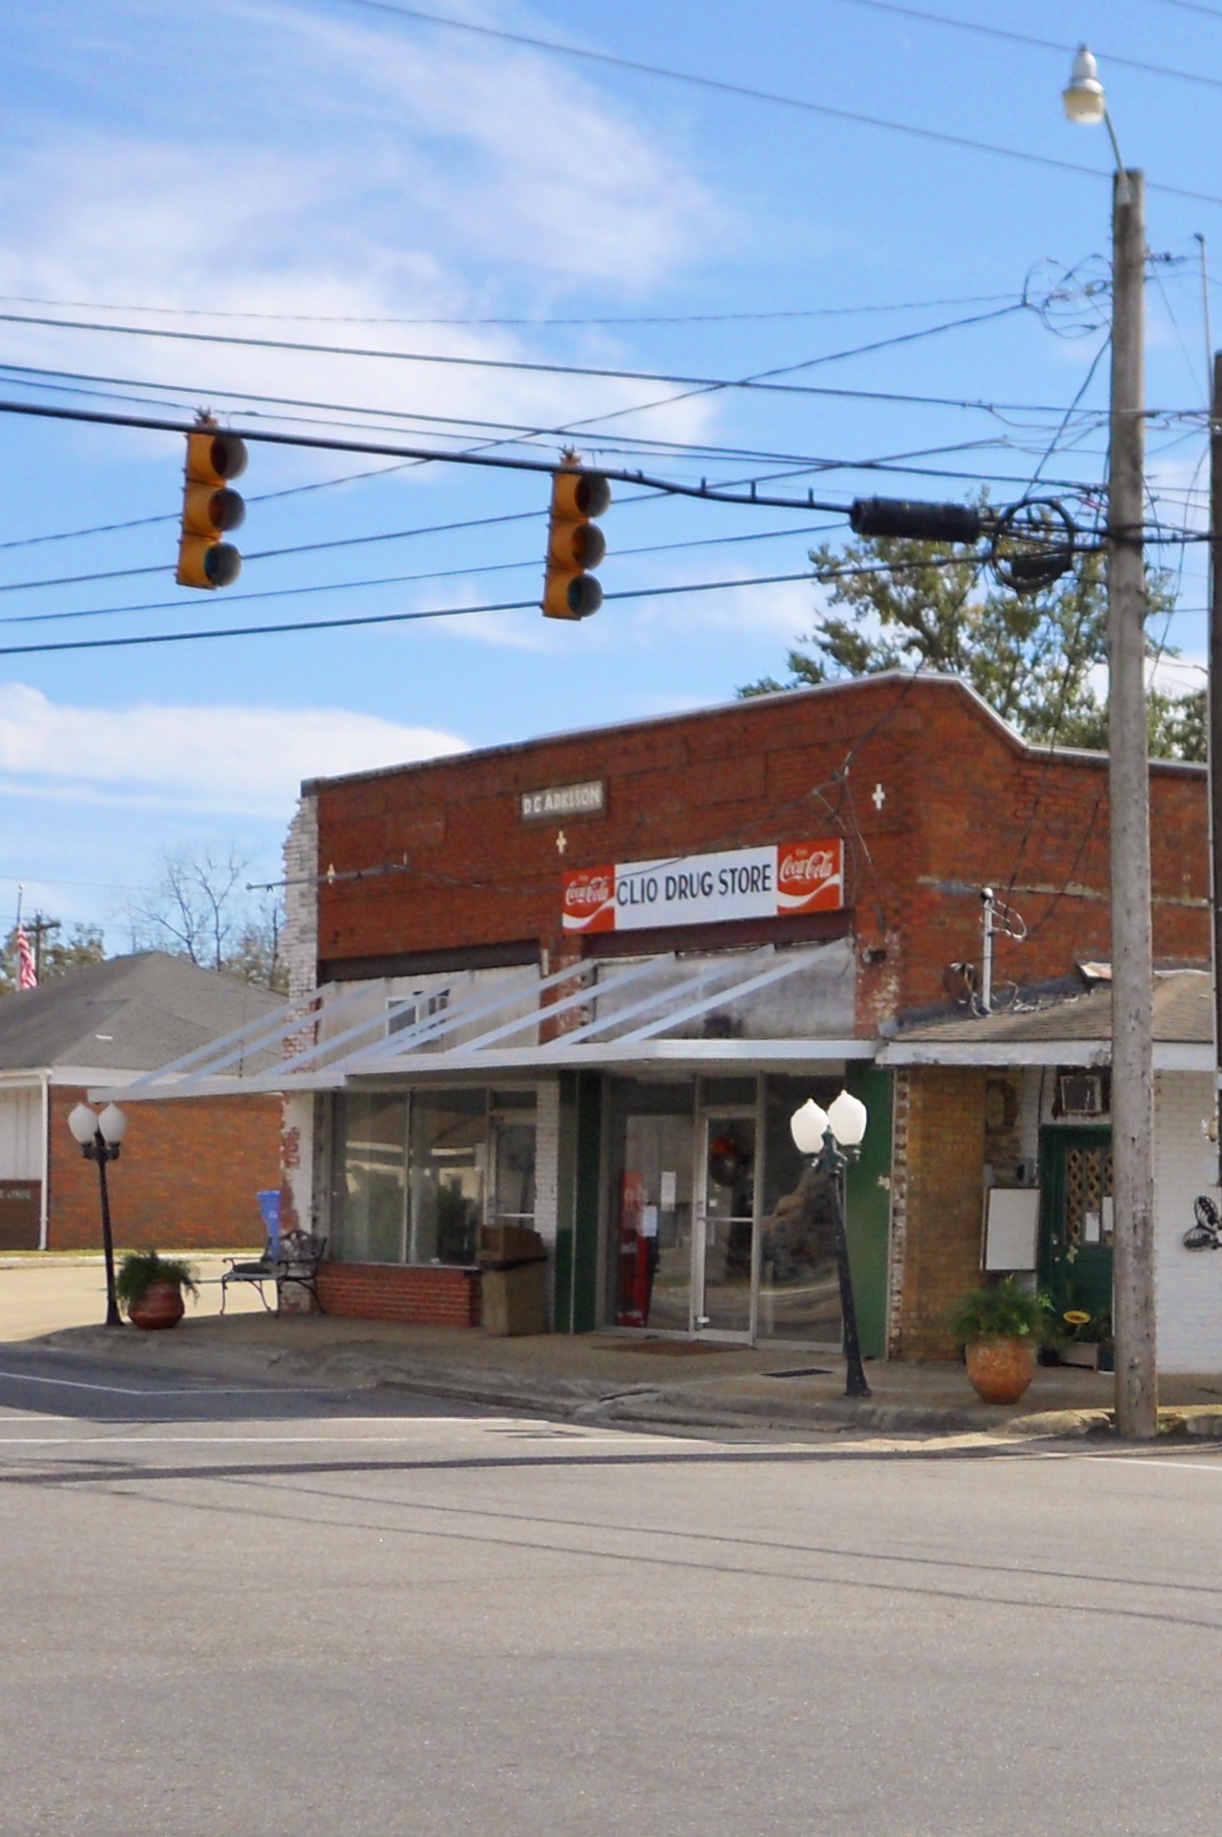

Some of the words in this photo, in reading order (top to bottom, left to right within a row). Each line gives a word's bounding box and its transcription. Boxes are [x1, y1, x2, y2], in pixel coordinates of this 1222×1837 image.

[616, 877, 659, 907] CLIO
[665, 871, 714, 901] DRUG
[718, 863, 772, 896] STORE
[780, 851, 833, 882] Coca-Cola
